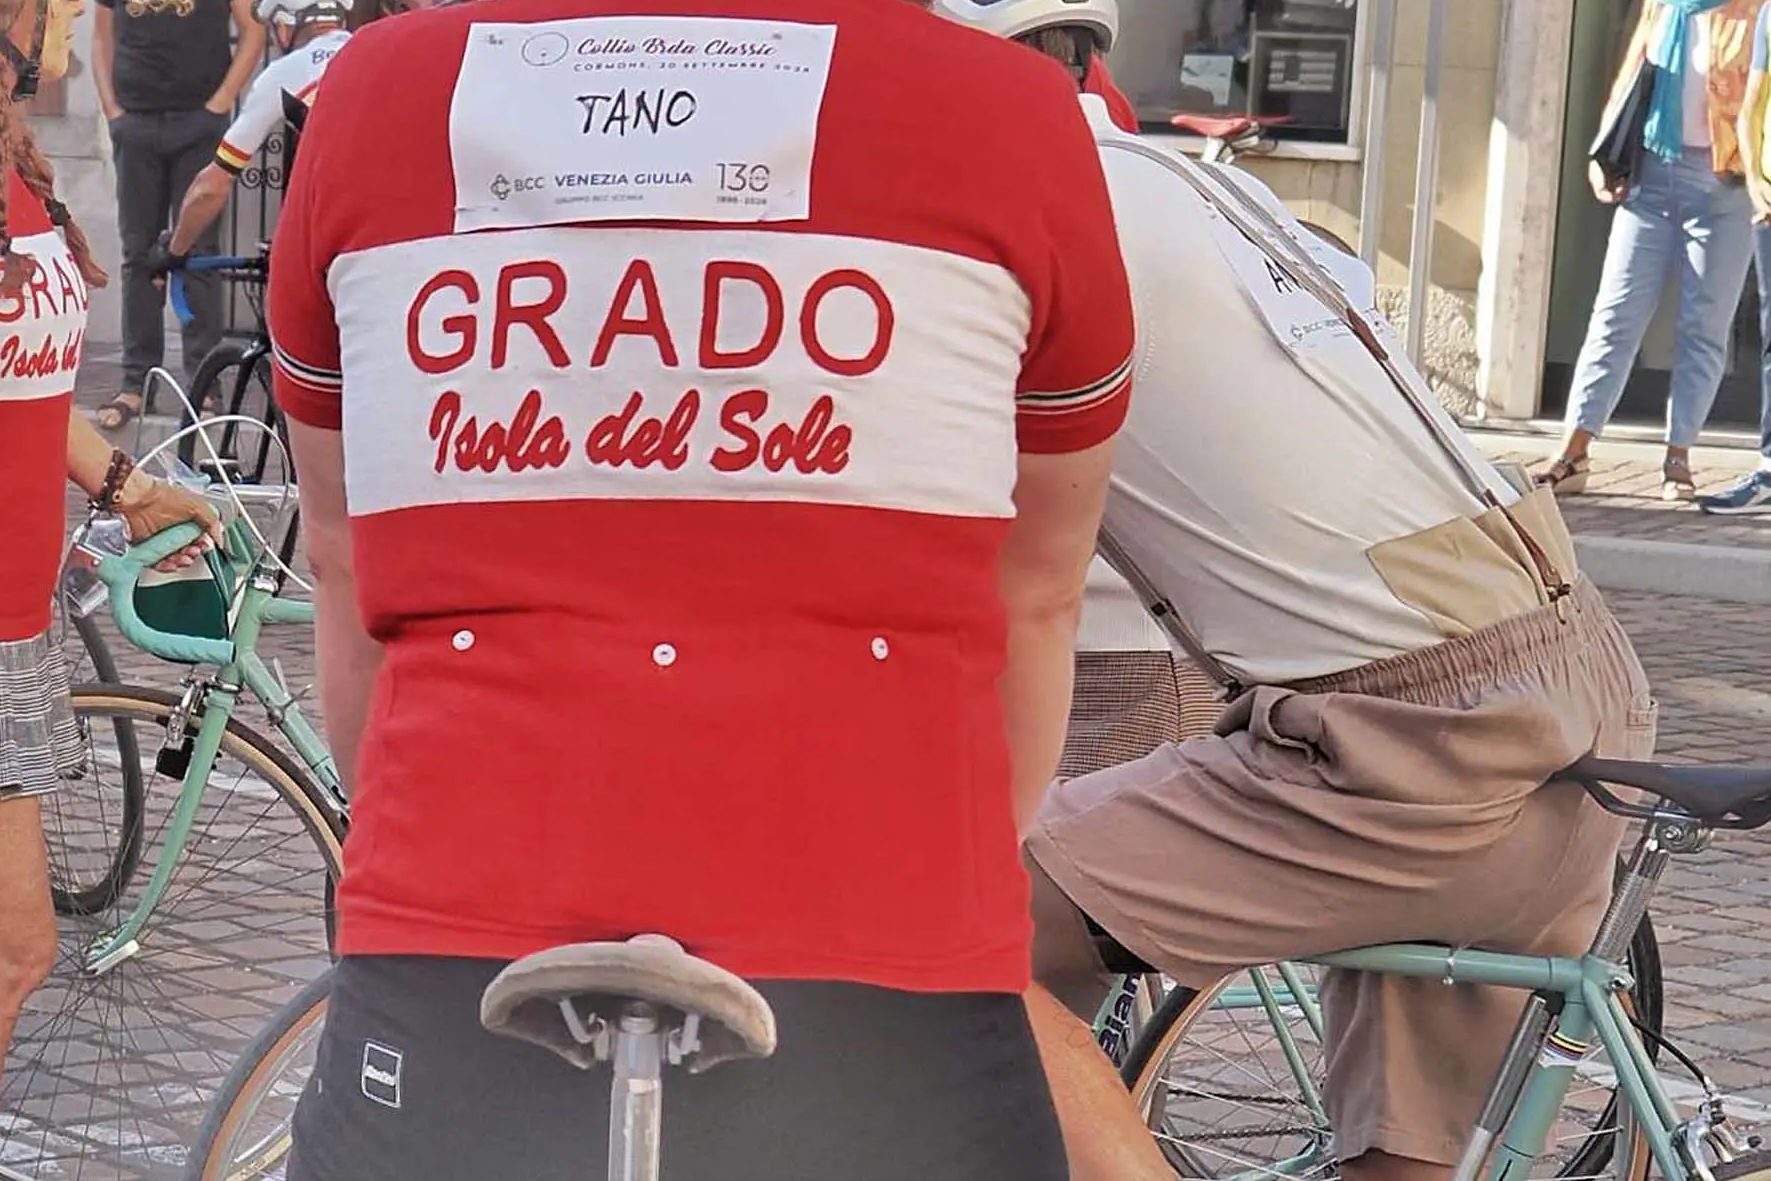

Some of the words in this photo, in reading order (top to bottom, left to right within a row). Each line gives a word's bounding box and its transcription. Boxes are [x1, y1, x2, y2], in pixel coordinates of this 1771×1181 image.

[578, 38, 636, 56] Collio
[704, 38, 776, 56] Classic
[577, 86, 697, 137] TANO
[514, 175, 545, 192] BCC
[554, 172, 629, 187] VENEZIA
[634, 171, 693, 186] GIULIA
[715, 163, 770, 193] 130
[406, 258, 895, 377] GRADO
[429, 389, 571, 475] Isola
[585, 388, 701, 471] del
[708, 389, 853, 475] Sole
